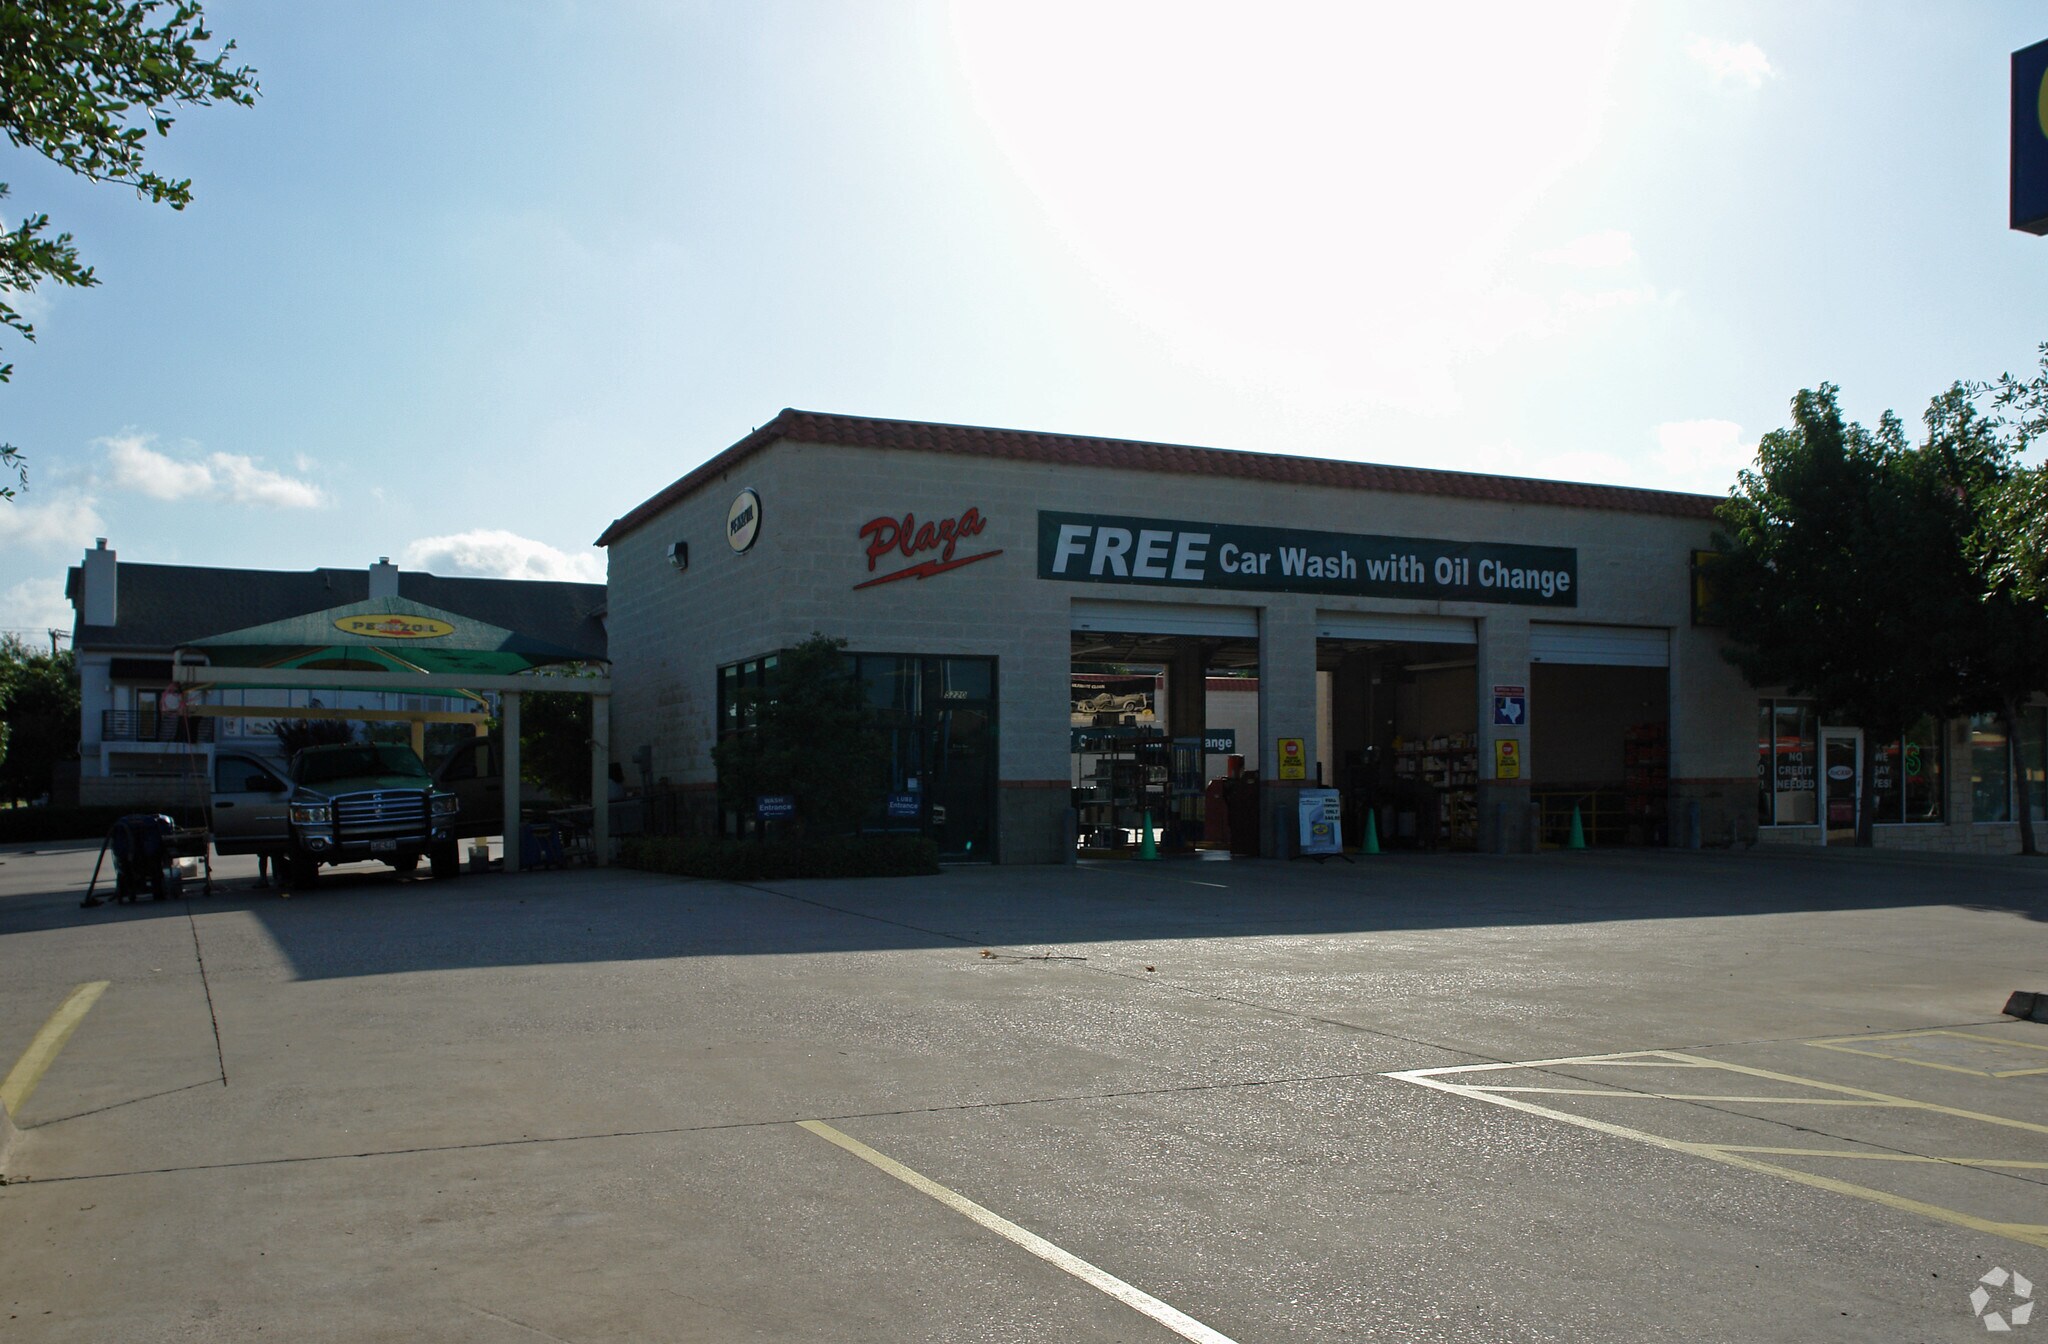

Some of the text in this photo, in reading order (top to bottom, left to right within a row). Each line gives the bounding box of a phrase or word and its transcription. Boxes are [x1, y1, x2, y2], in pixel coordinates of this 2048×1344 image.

[859, 506, 988, 573] Plaza
[1052, 523, 1571, 598] FREE Car Wash with Oil Change
[1788, 752, 1803, 762] NO
[1778, 765, 1813, 776] CREDIT
[1776, 779, 1815, 790] NEEDED
